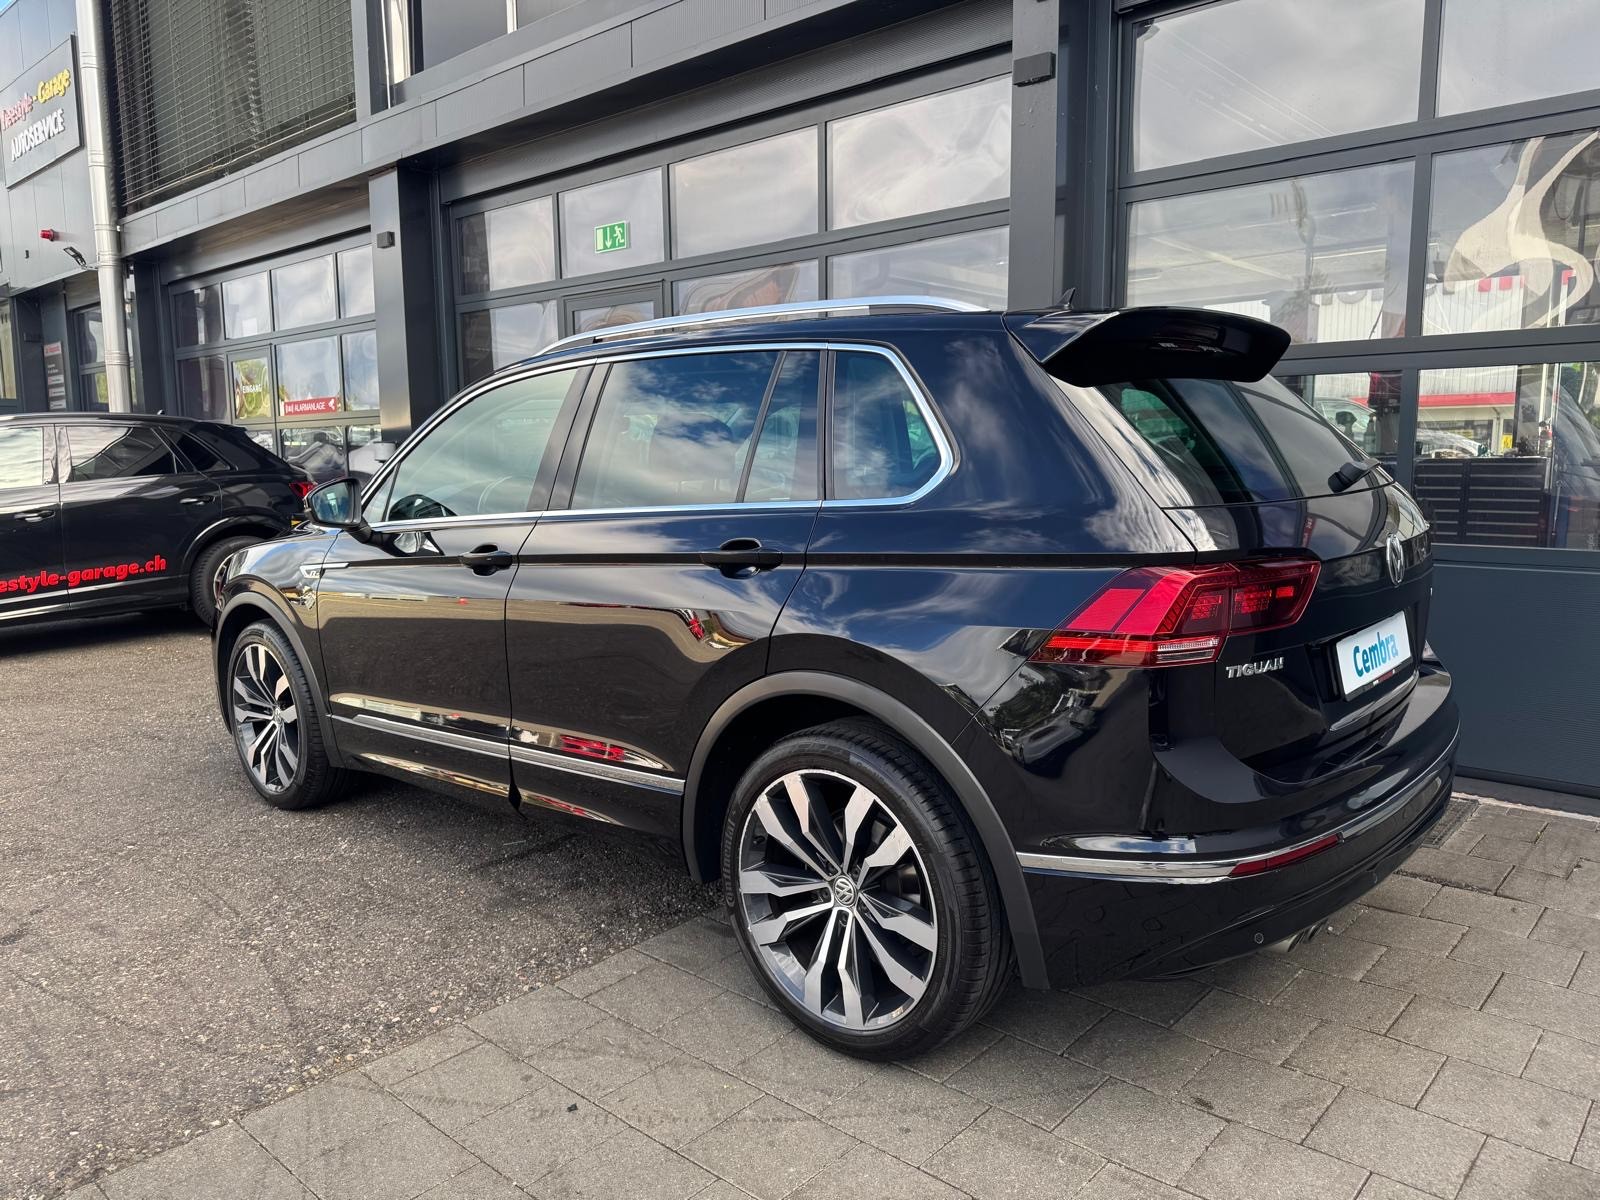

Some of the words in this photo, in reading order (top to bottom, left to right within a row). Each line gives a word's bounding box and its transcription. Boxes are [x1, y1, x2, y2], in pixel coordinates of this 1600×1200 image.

[11, 108, 65, 162] AUTOSERVICE
[1225, 656, 1284, 679] TIGUAN
[1353, 631, 1399, 678] Cembra
